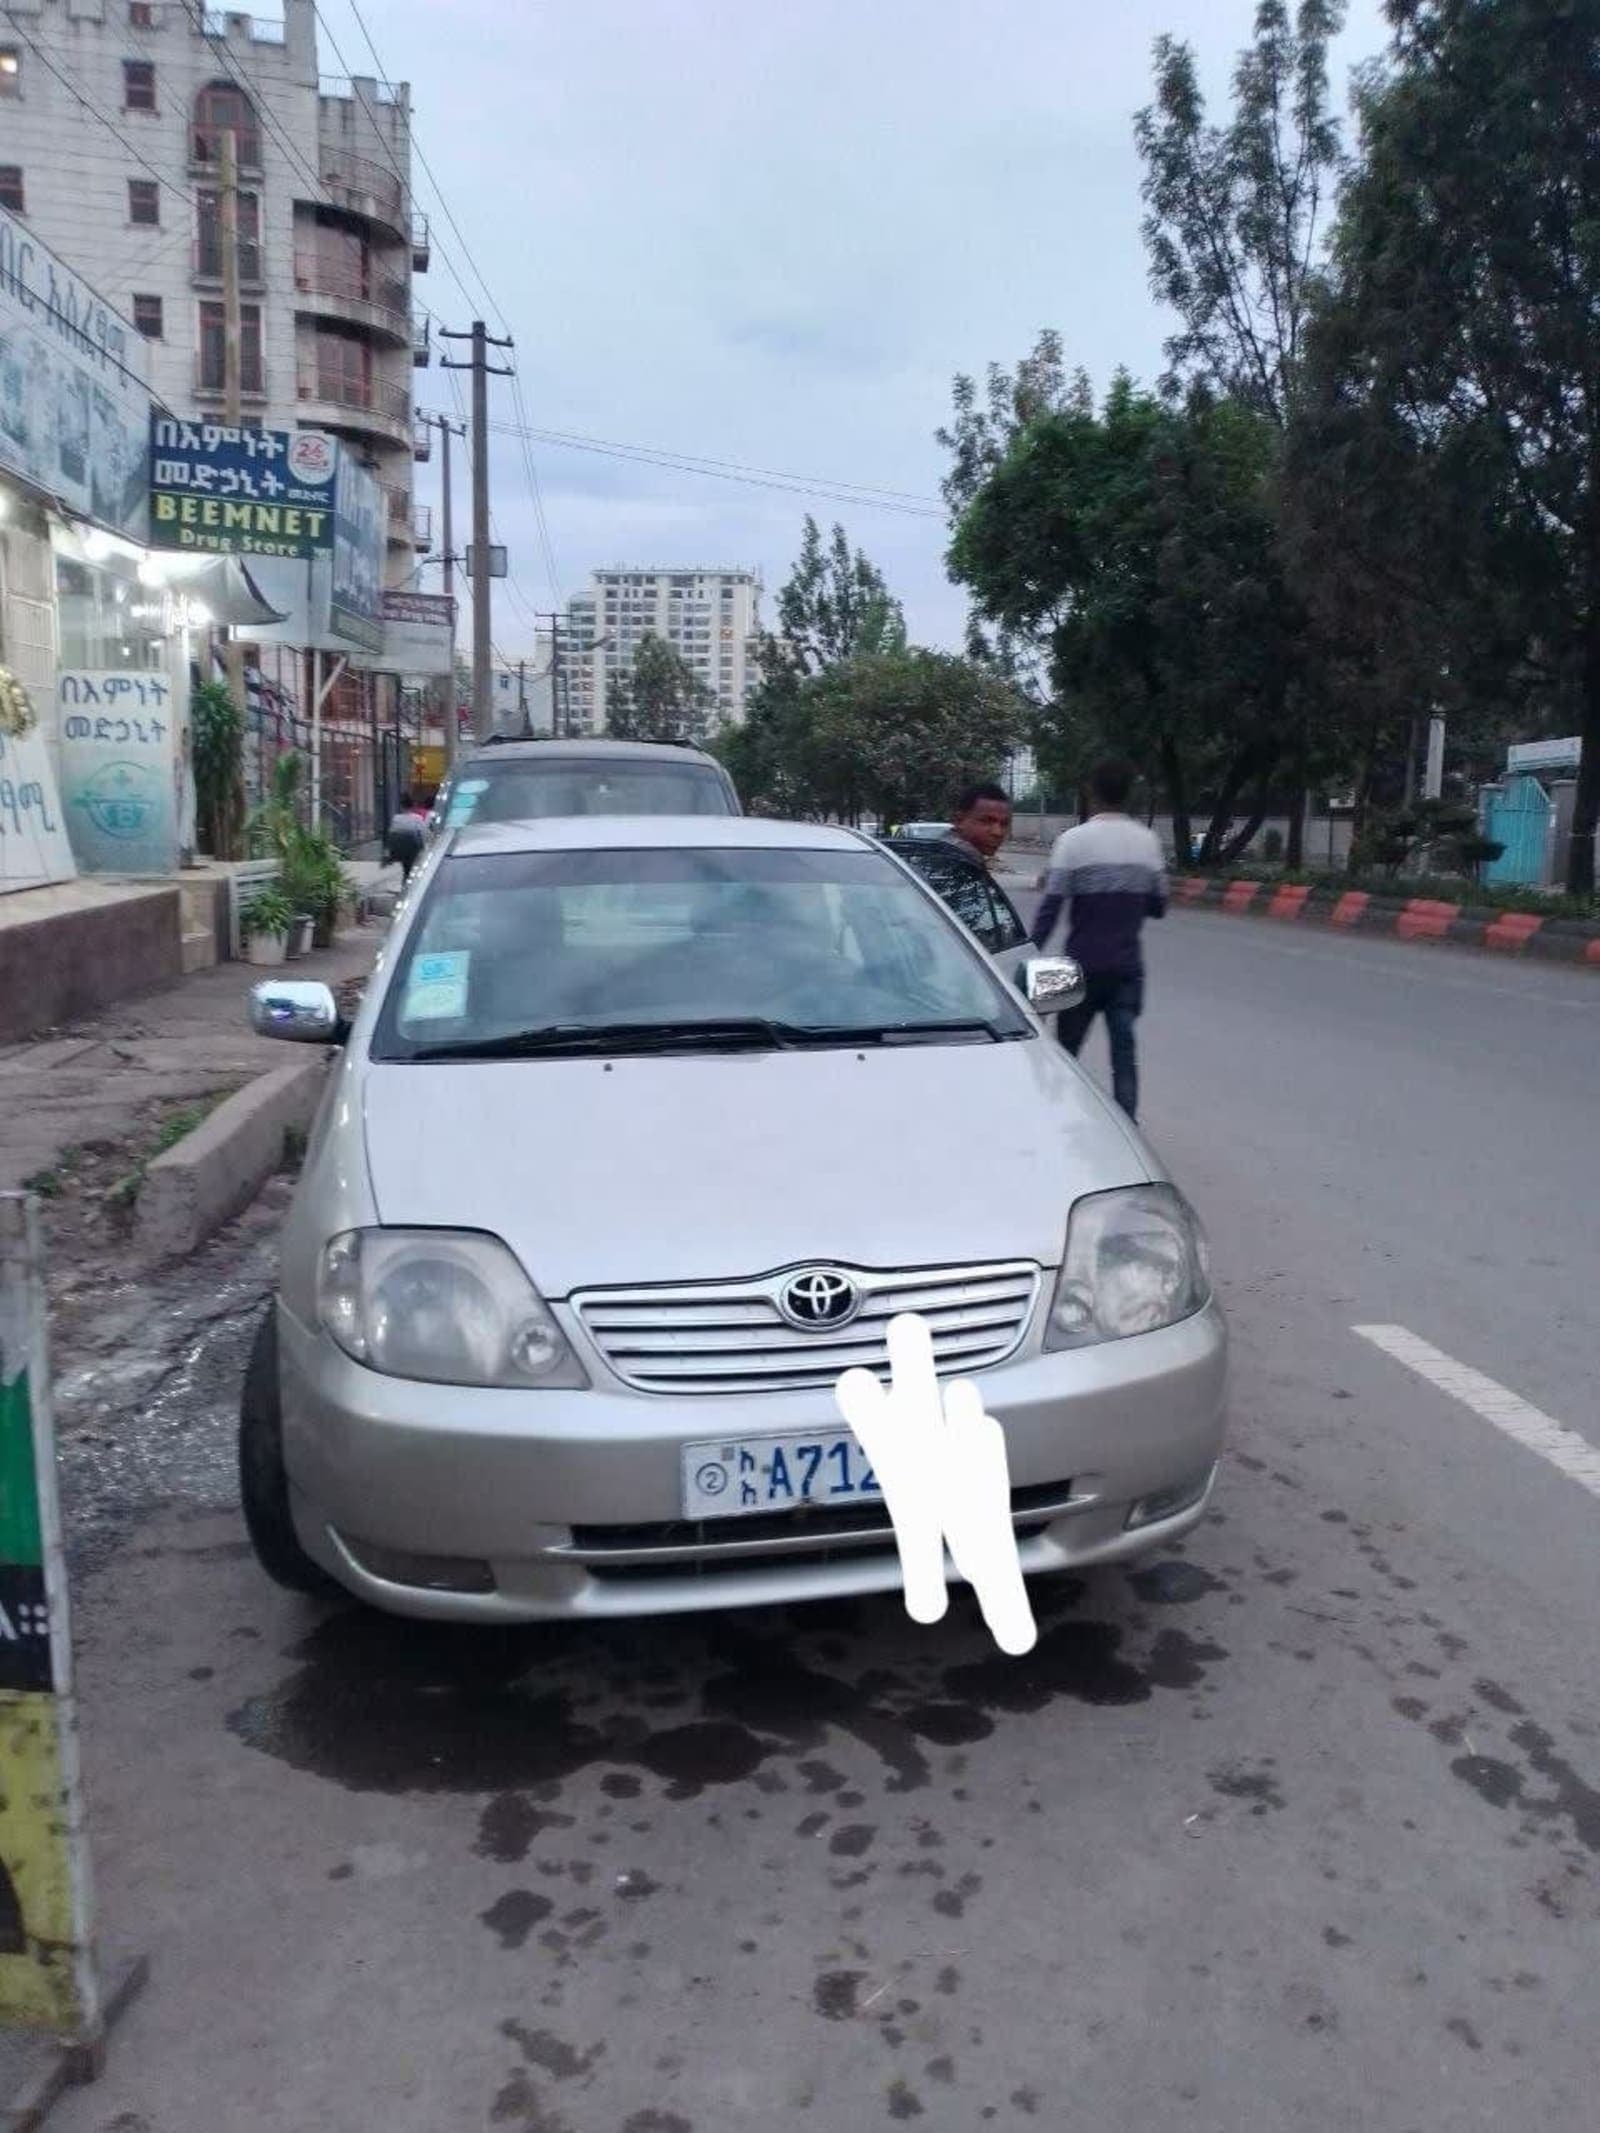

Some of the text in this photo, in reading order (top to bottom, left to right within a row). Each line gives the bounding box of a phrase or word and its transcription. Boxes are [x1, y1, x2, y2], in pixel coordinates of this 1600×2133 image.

[156, 494, 326, 538] BEEMNET
[180, 528, 232, 552] Drug
[241, 536, 298, 557] Store
